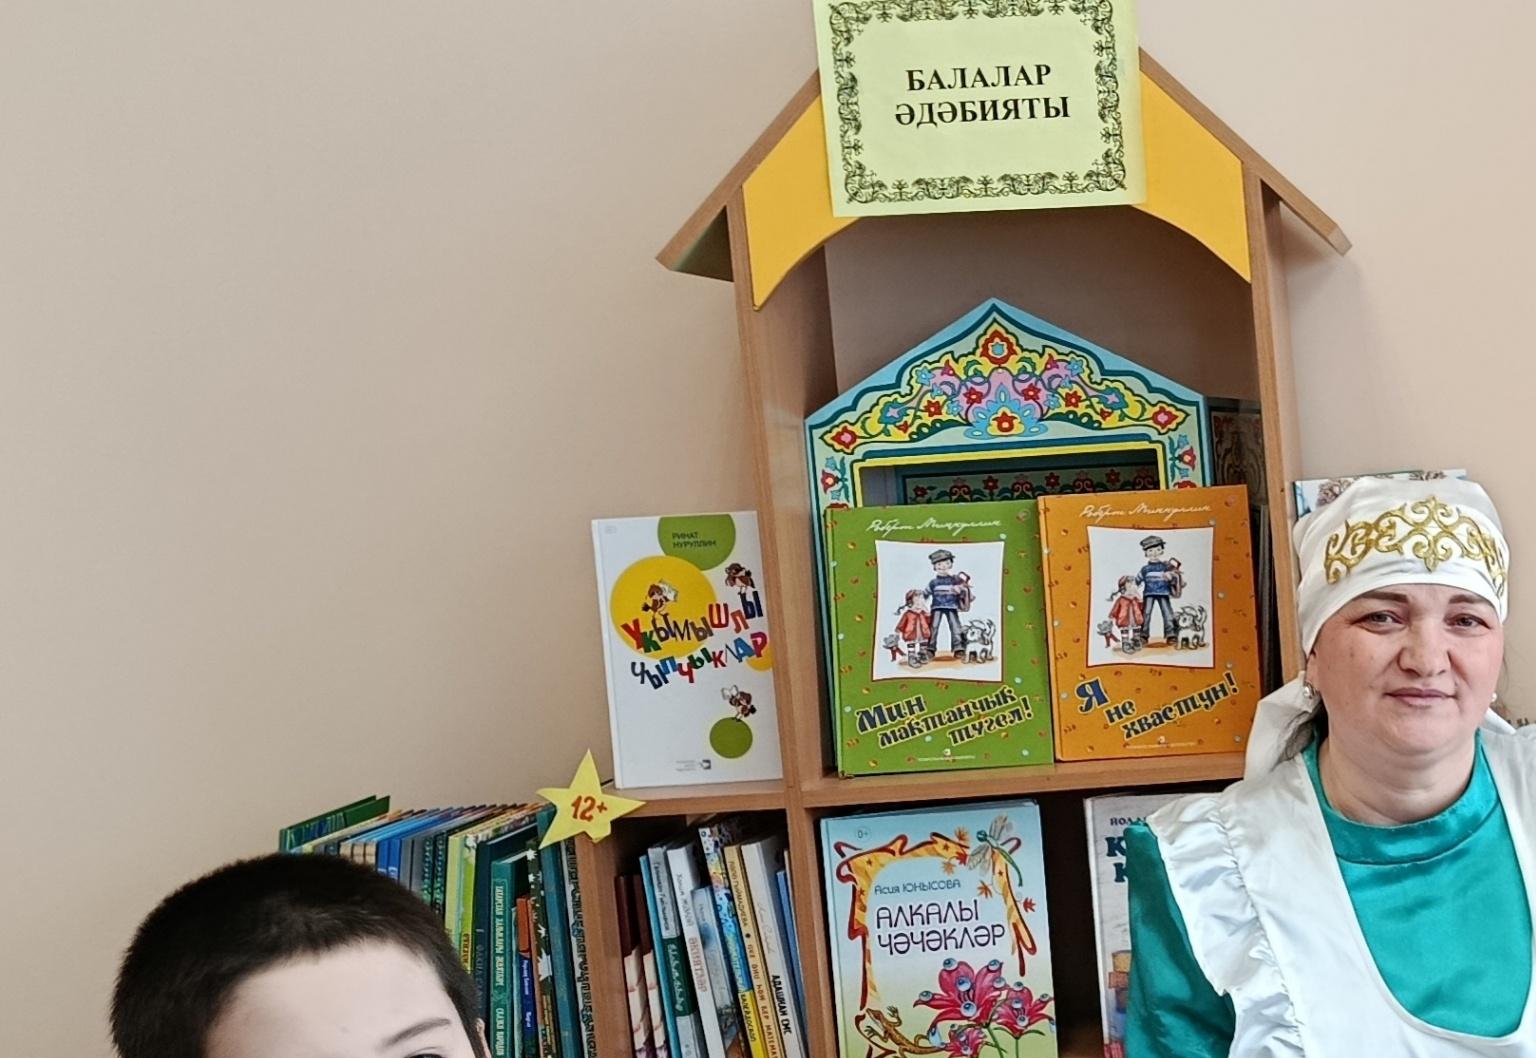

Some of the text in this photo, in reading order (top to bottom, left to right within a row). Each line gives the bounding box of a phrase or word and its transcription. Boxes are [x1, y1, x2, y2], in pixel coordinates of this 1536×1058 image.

[905, 64, 1051, 91] БАЛАЛАР
[895, 97, 1070, 129] ӘДӘБИЯТЫ
[672, 531, 699, 540] РИНАТ
[672, 539, 717, 549] НУРУЛЛИН
[1075, 677, 1108, 714] Я
[1122, 672, 1239, 741] хвастун!
[856, 694, 926, 733] Мин
[878, 686, 1018, 750] мактанчык
[1104, 699, 1137, 726] не
[571, 795, 608, 822] 12+
[874, 879, 961, 896] Асия ЮНЫСОВА
[876, 899, 979, 930] АЛКАЛЫ
[877, 924, 1005, 956] ЧӘЧӘКЛӘР
